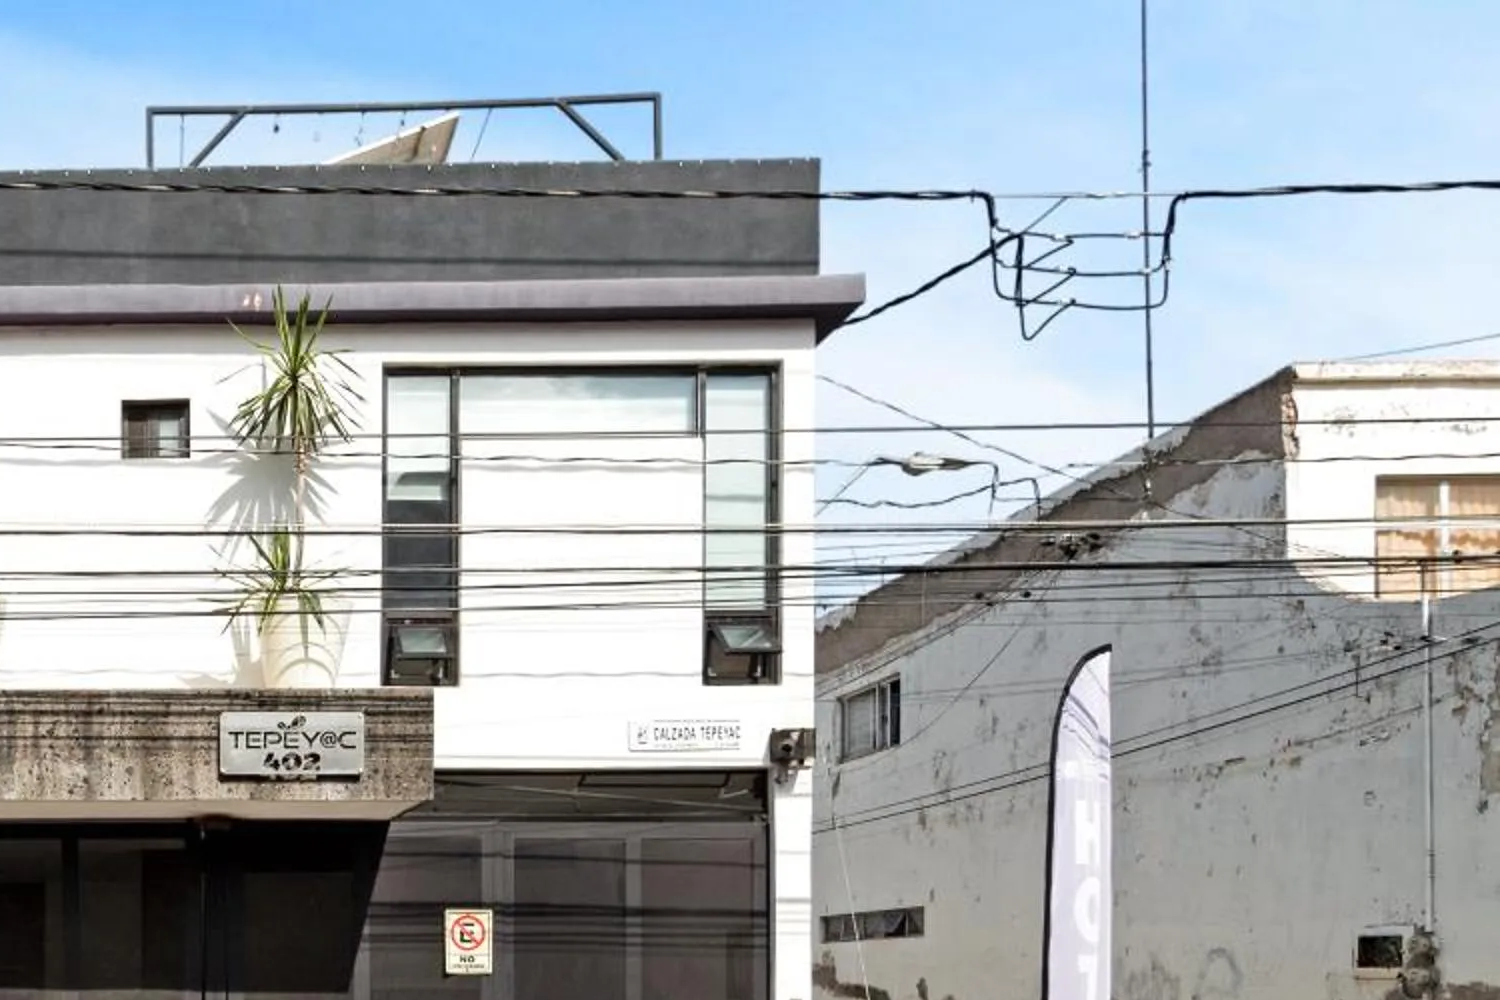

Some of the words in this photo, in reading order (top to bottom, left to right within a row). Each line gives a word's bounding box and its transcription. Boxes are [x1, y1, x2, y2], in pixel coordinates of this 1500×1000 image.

[228, 731, 357, 749] TEPEY@C
[654, 727, 696, 741] CALZADA
[700, 725, 741, 741] TEPEYAC
[264, 752, 321, 771] 402
